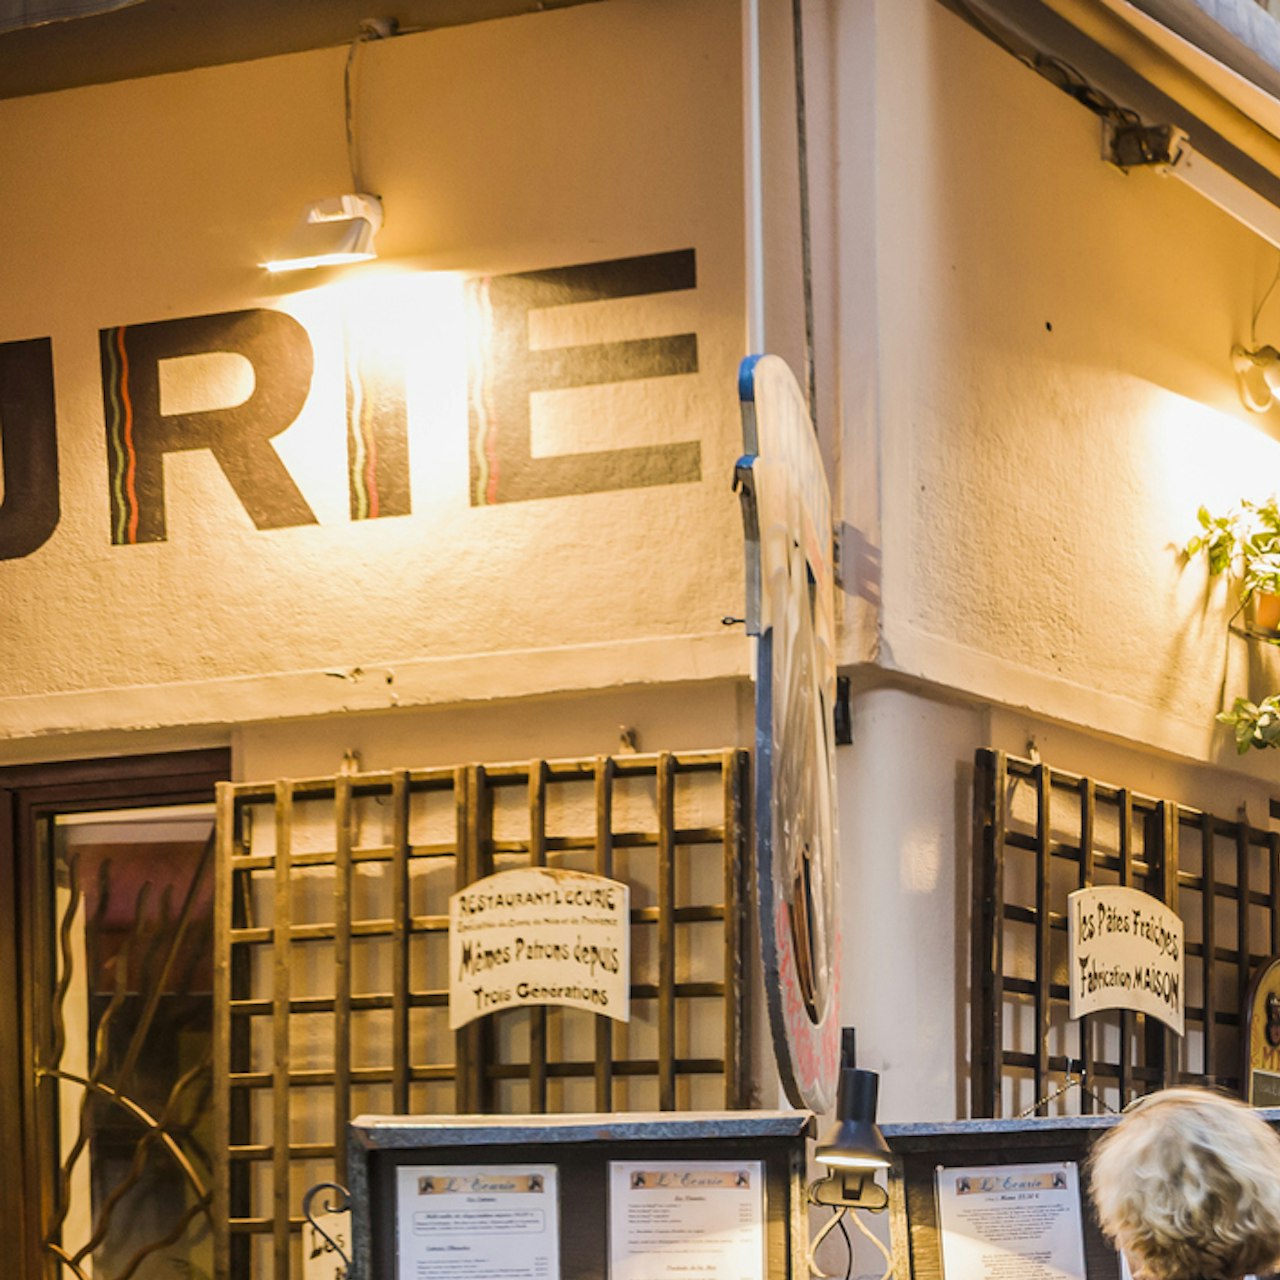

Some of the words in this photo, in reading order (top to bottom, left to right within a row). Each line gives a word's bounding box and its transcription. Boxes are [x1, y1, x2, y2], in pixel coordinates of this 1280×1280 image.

[458, 940, 510, 983] Mêmes
[515, 937, 569, 961] Patrons
[573, 933, 619, 978] depuis
[1078, 954, 1132, 998] Fabrication
[472, 984, 511, 1010] Trois
